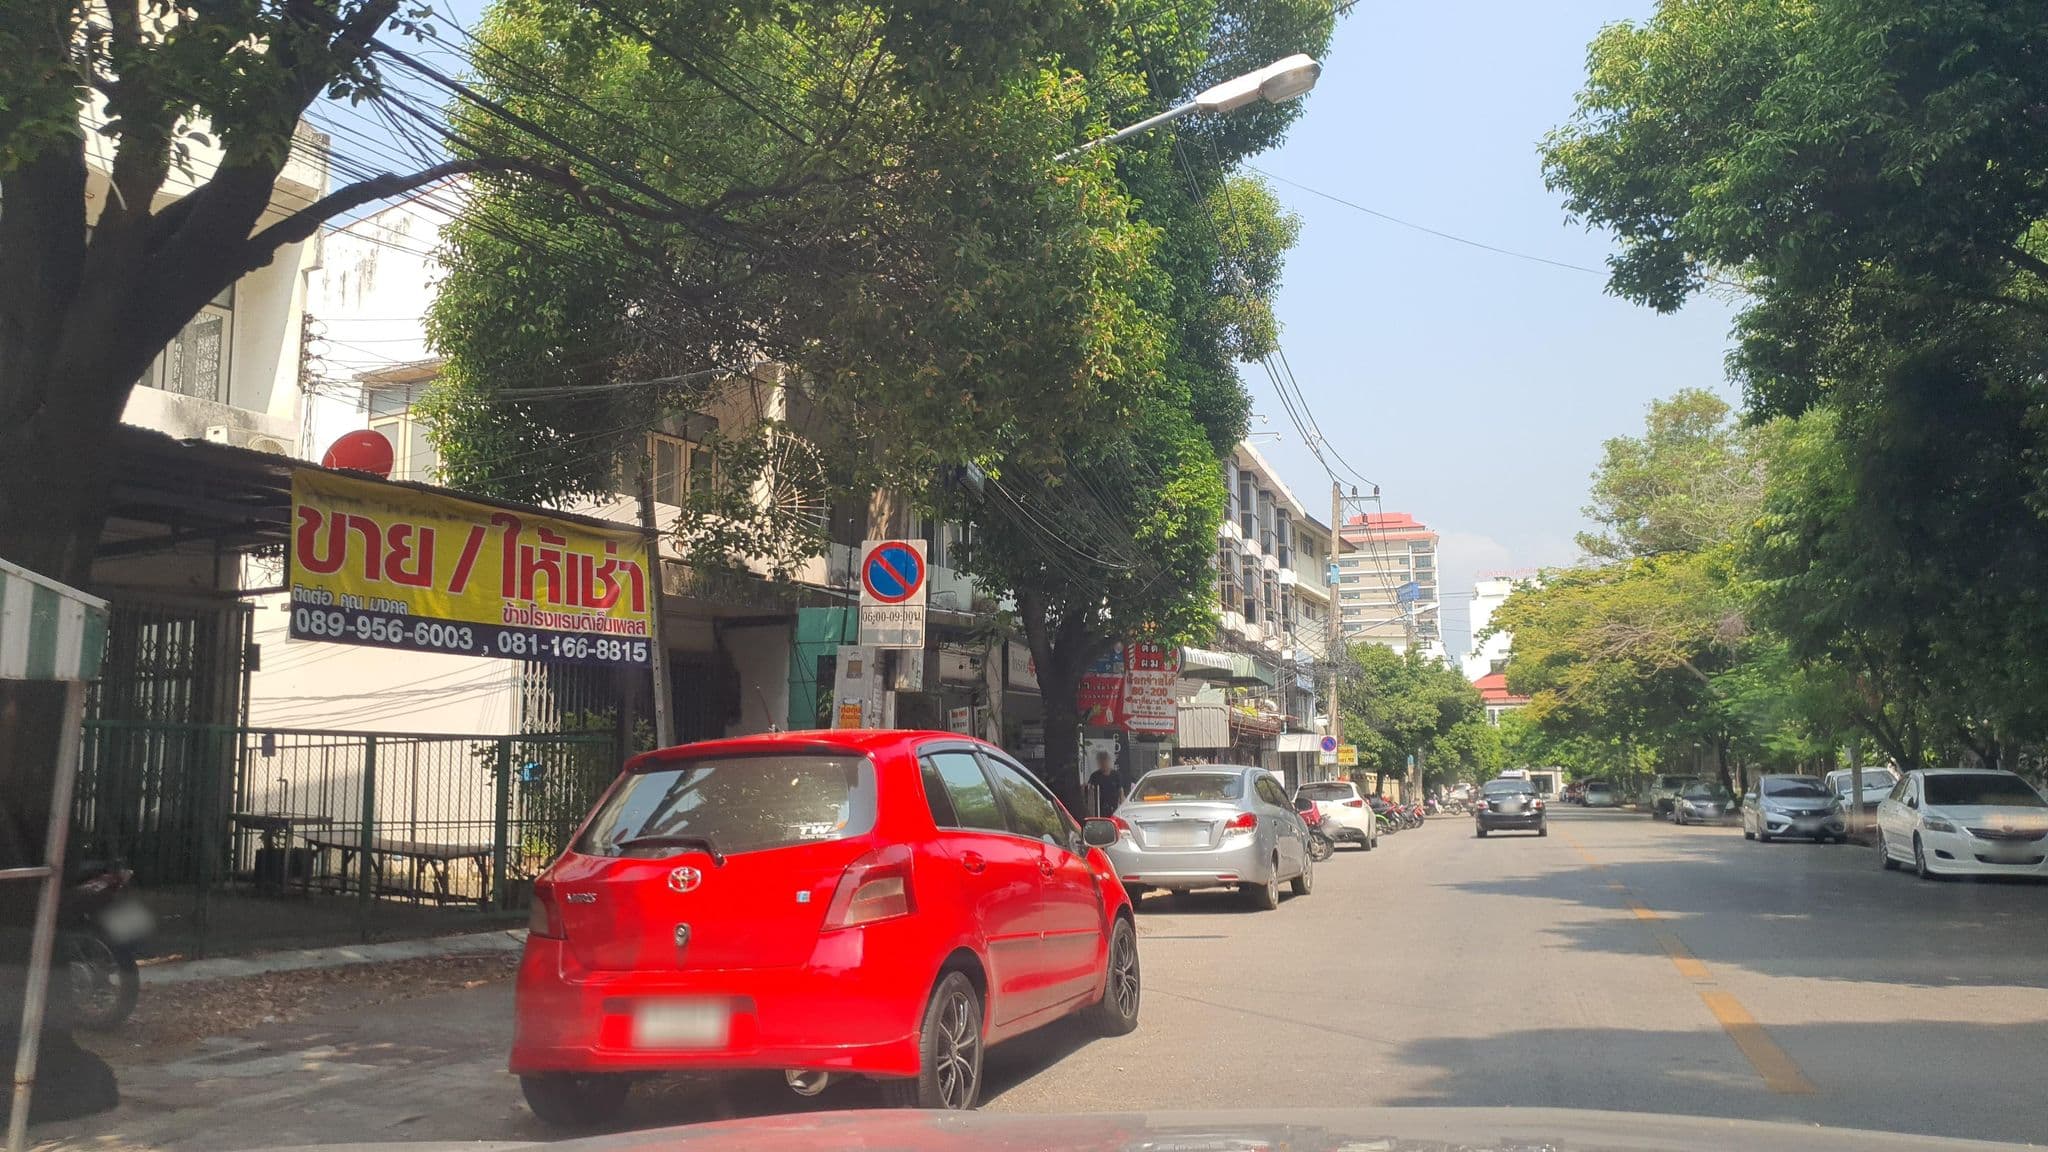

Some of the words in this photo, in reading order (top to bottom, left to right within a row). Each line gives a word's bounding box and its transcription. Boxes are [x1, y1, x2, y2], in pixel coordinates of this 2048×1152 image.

[297, 505, 436, 588] ขาย
[447, 525, 487, 595] /
[490, 511, 646, 613] ให้เช่า
[292, 583, 334, 607] ติดต่อ
[340, 593, 364, 614] คุณ
[295, 607, 474, 651] 089-956-6003
[497, 630, 648, 663] 081-166-8815
